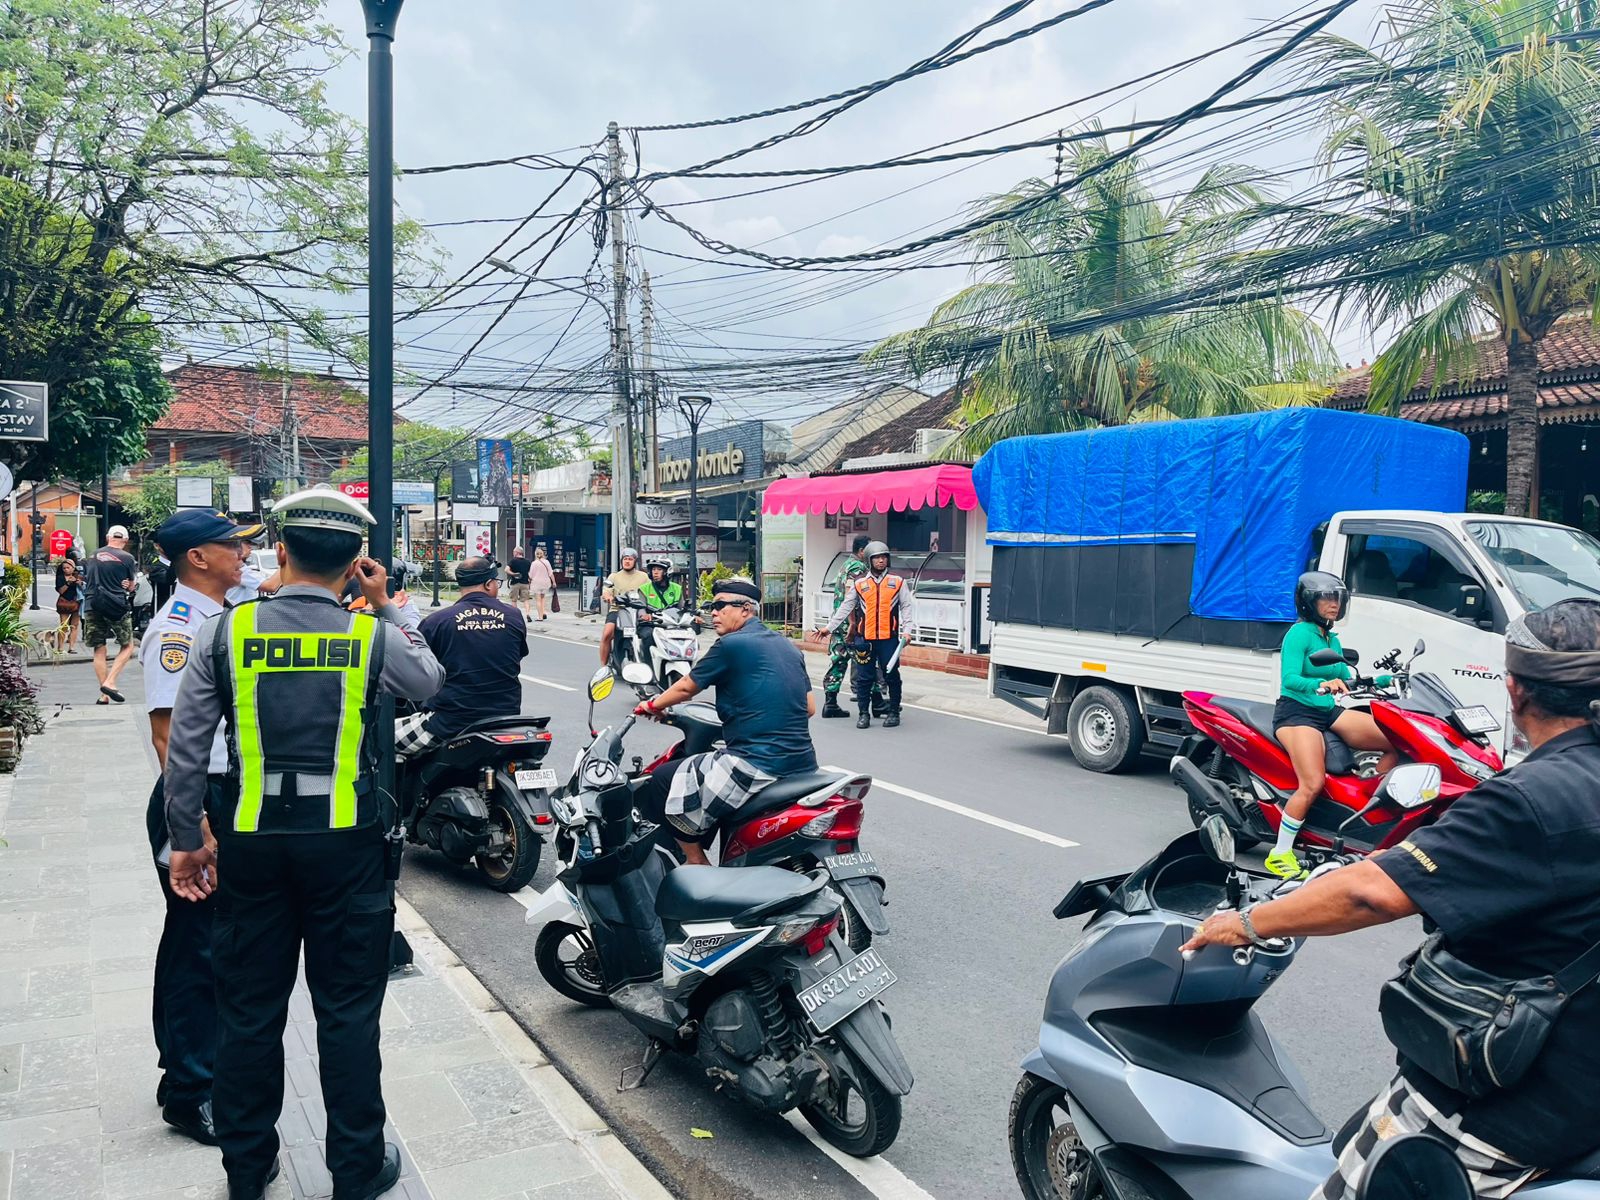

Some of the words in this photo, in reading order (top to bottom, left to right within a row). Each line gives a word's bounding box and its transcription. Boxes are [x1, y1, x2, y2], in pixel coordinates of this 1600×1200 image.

[455, 608, 479, 623] JAGA
[480, 607, 505, 621] BAYA
[457, 623, 506, 631] INTARAN
[242, 638, 361, 668] POLISI
[1452, 668, 1503, 680] TRAGA
[1466, 664, 1489, 672] ISUZU
[802, 989, 827, 1012] DK
